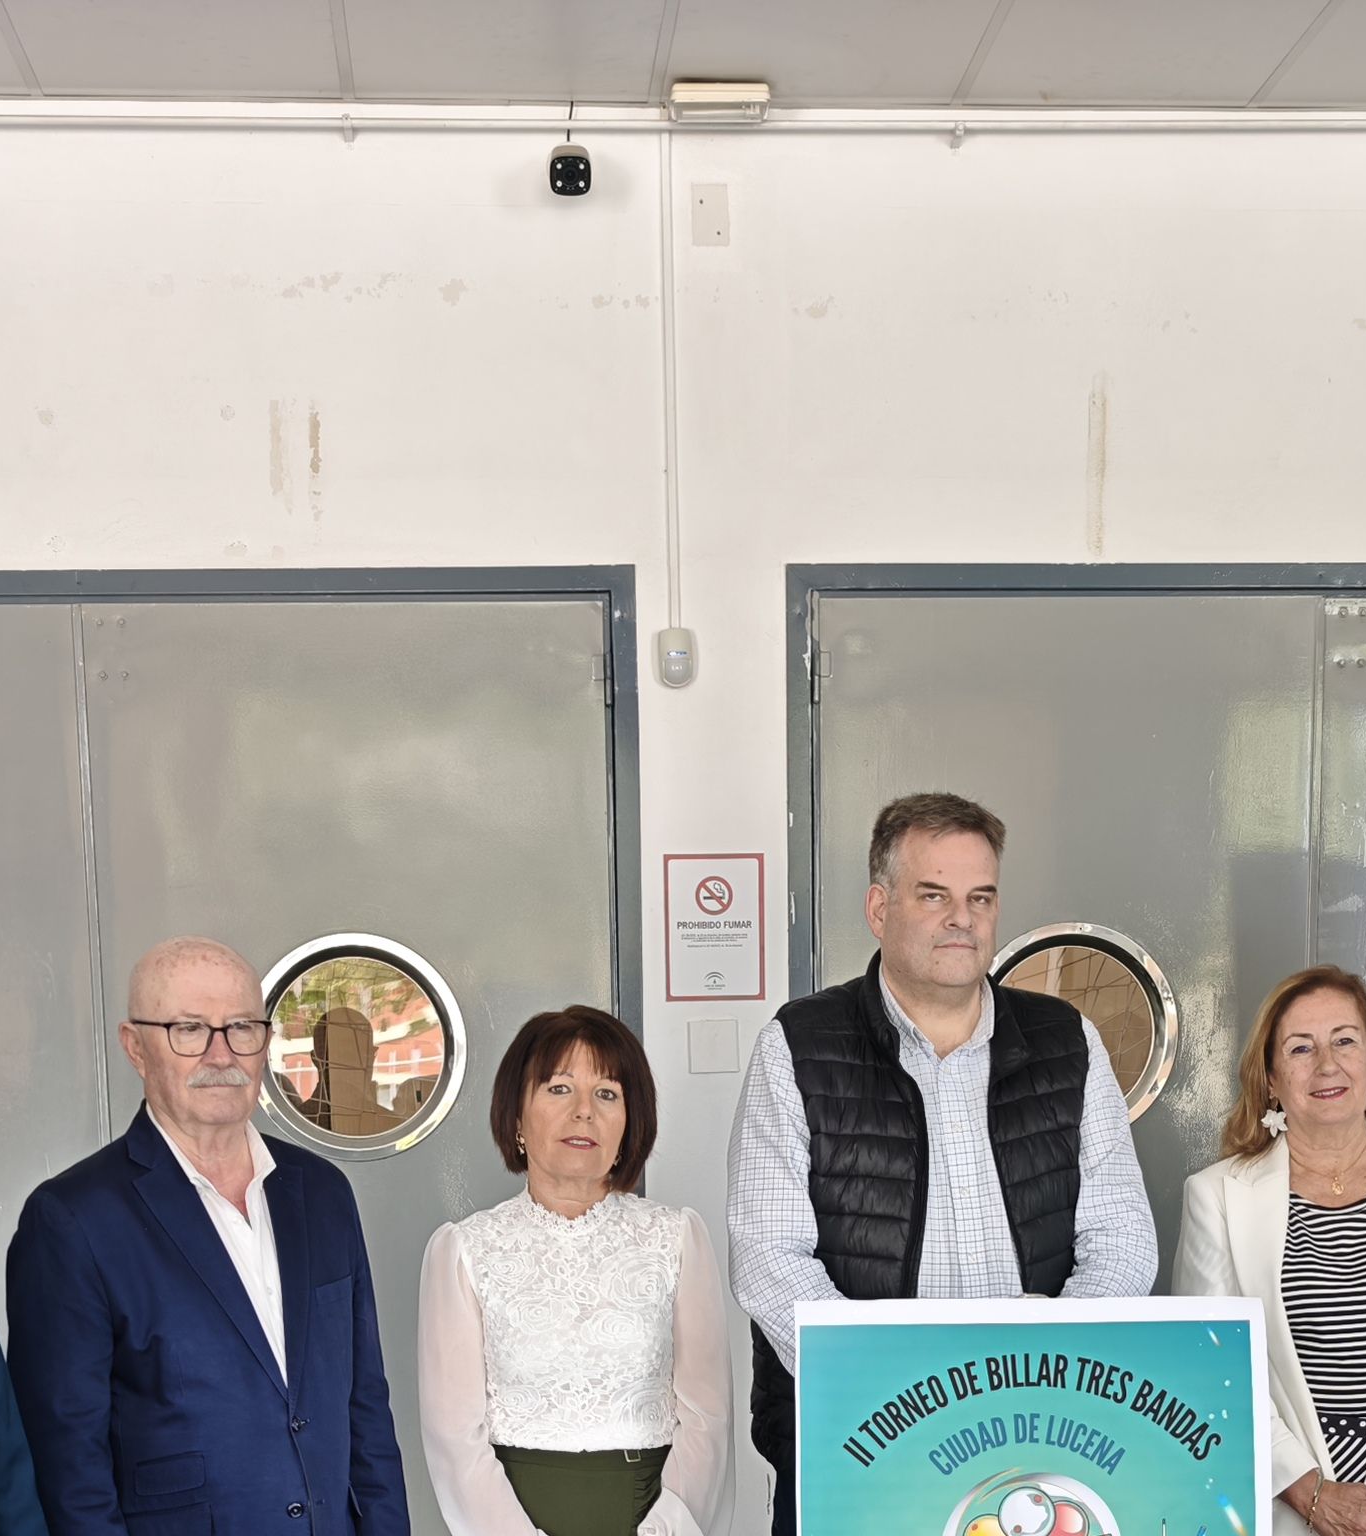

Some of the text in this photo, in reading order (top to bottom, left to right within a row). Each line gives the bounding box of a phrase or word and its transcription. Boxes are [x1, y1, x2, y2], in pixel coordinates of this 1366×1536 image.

[677, 920, 752, 930] PROHIBIDO FUMAR
[842, 1352, 1222, 1468] II TORNEO DE BILLAR TRES BANDAS
[928, 1413, 1127, 1476] CIUDAD DE LUCENA
